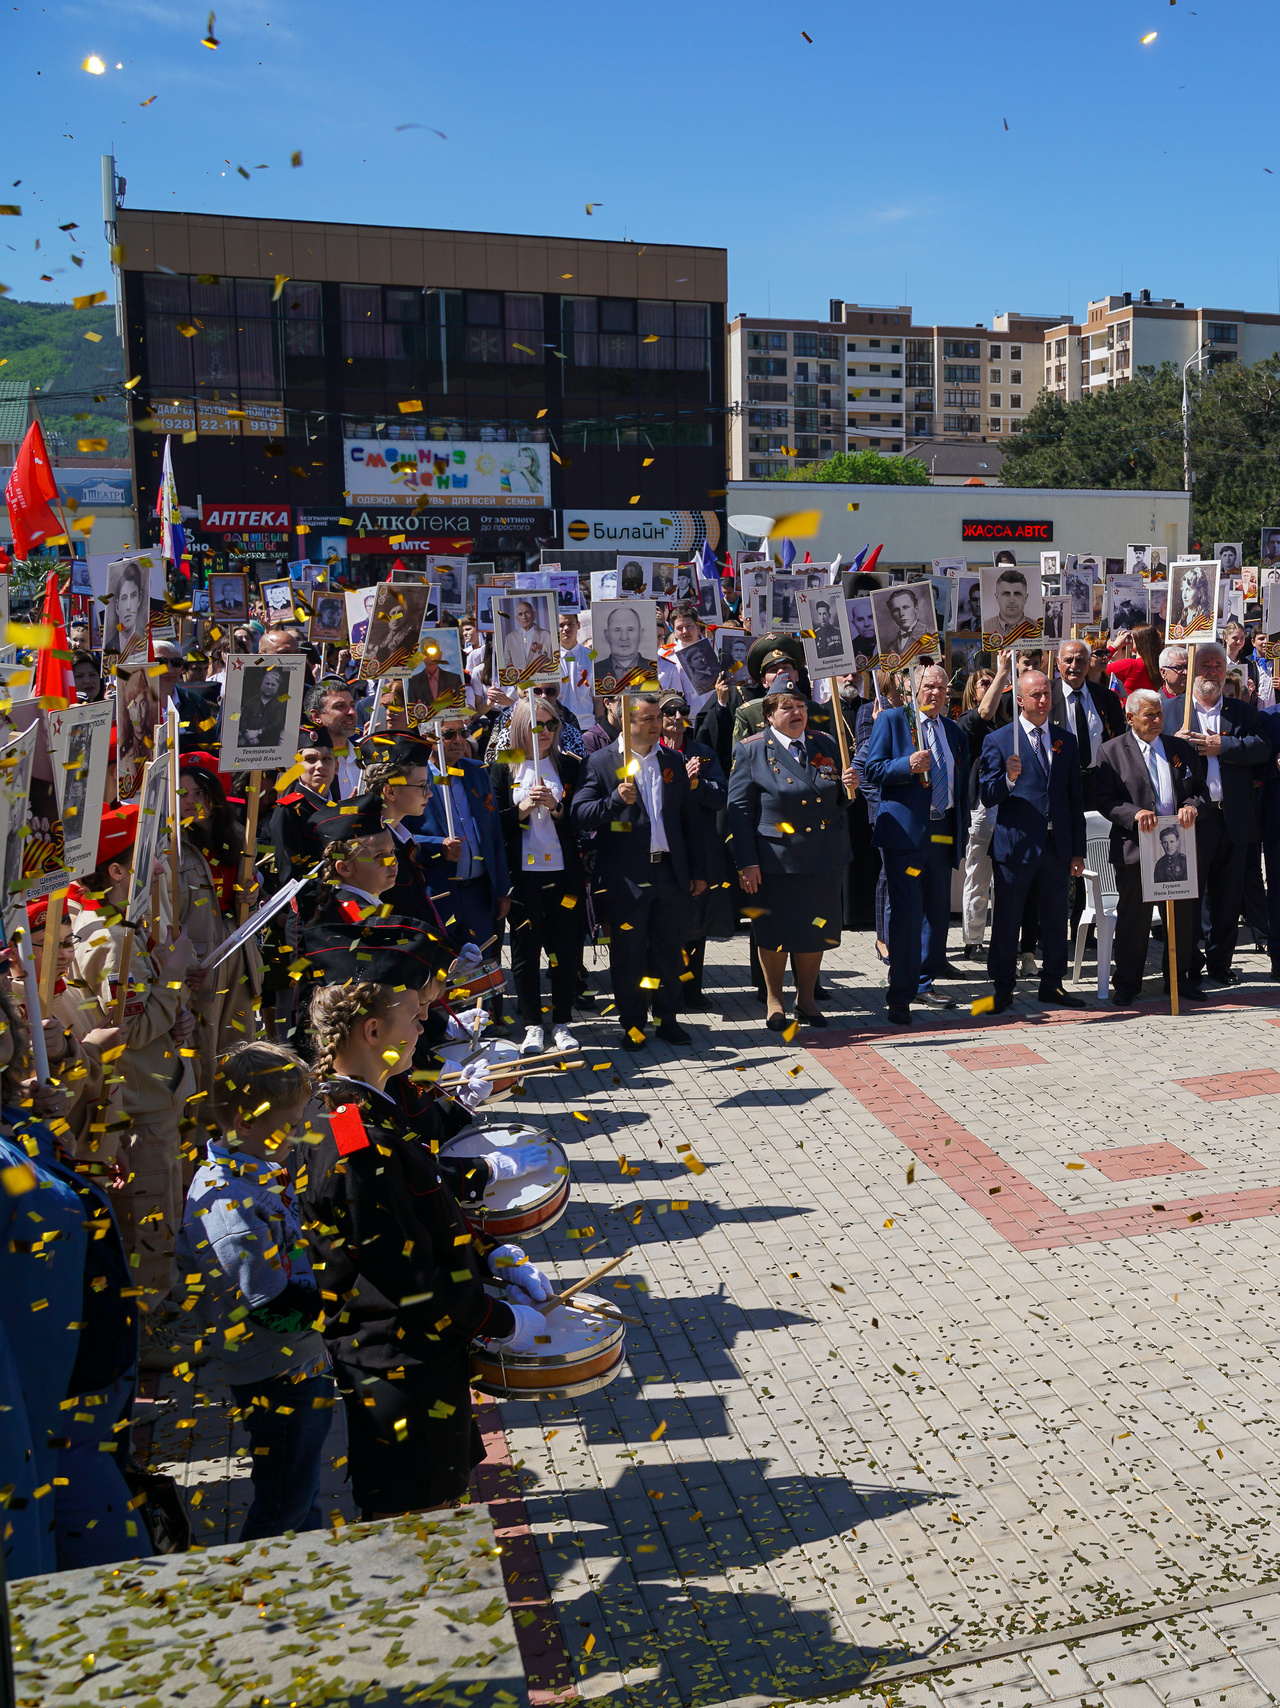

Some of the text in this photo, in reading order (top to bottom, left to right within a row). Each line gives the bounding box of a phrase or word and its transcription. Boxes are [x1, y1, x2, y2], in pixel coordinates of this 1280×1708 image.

[245, 406, 282, 418] НОМЕРА
[200, 419, 239, 430] 22-11
[250, 421, 278, 431] 999
[357, 496, 397, 505] ОДЕЖДА
[414, 496, 445, 505] ОУВЬ
[451, 497, 470, 505] ДЛЯ
[472, 496, 496, 505] ВСЕЙ
[505, 497, 536, 505] СЕМЬИ
[206, 511, 289, 526] АПТЕКА
[355, 511, 471, 532] Алкотека
[594, 522, 665, 539] Билайн
[401, 541, 430, 550] МТС
[234, 756, 263, 764] Григорий
[40, 871, 68, 884] Шевченко
[27, 880, 69, 897] Егор Петрович
